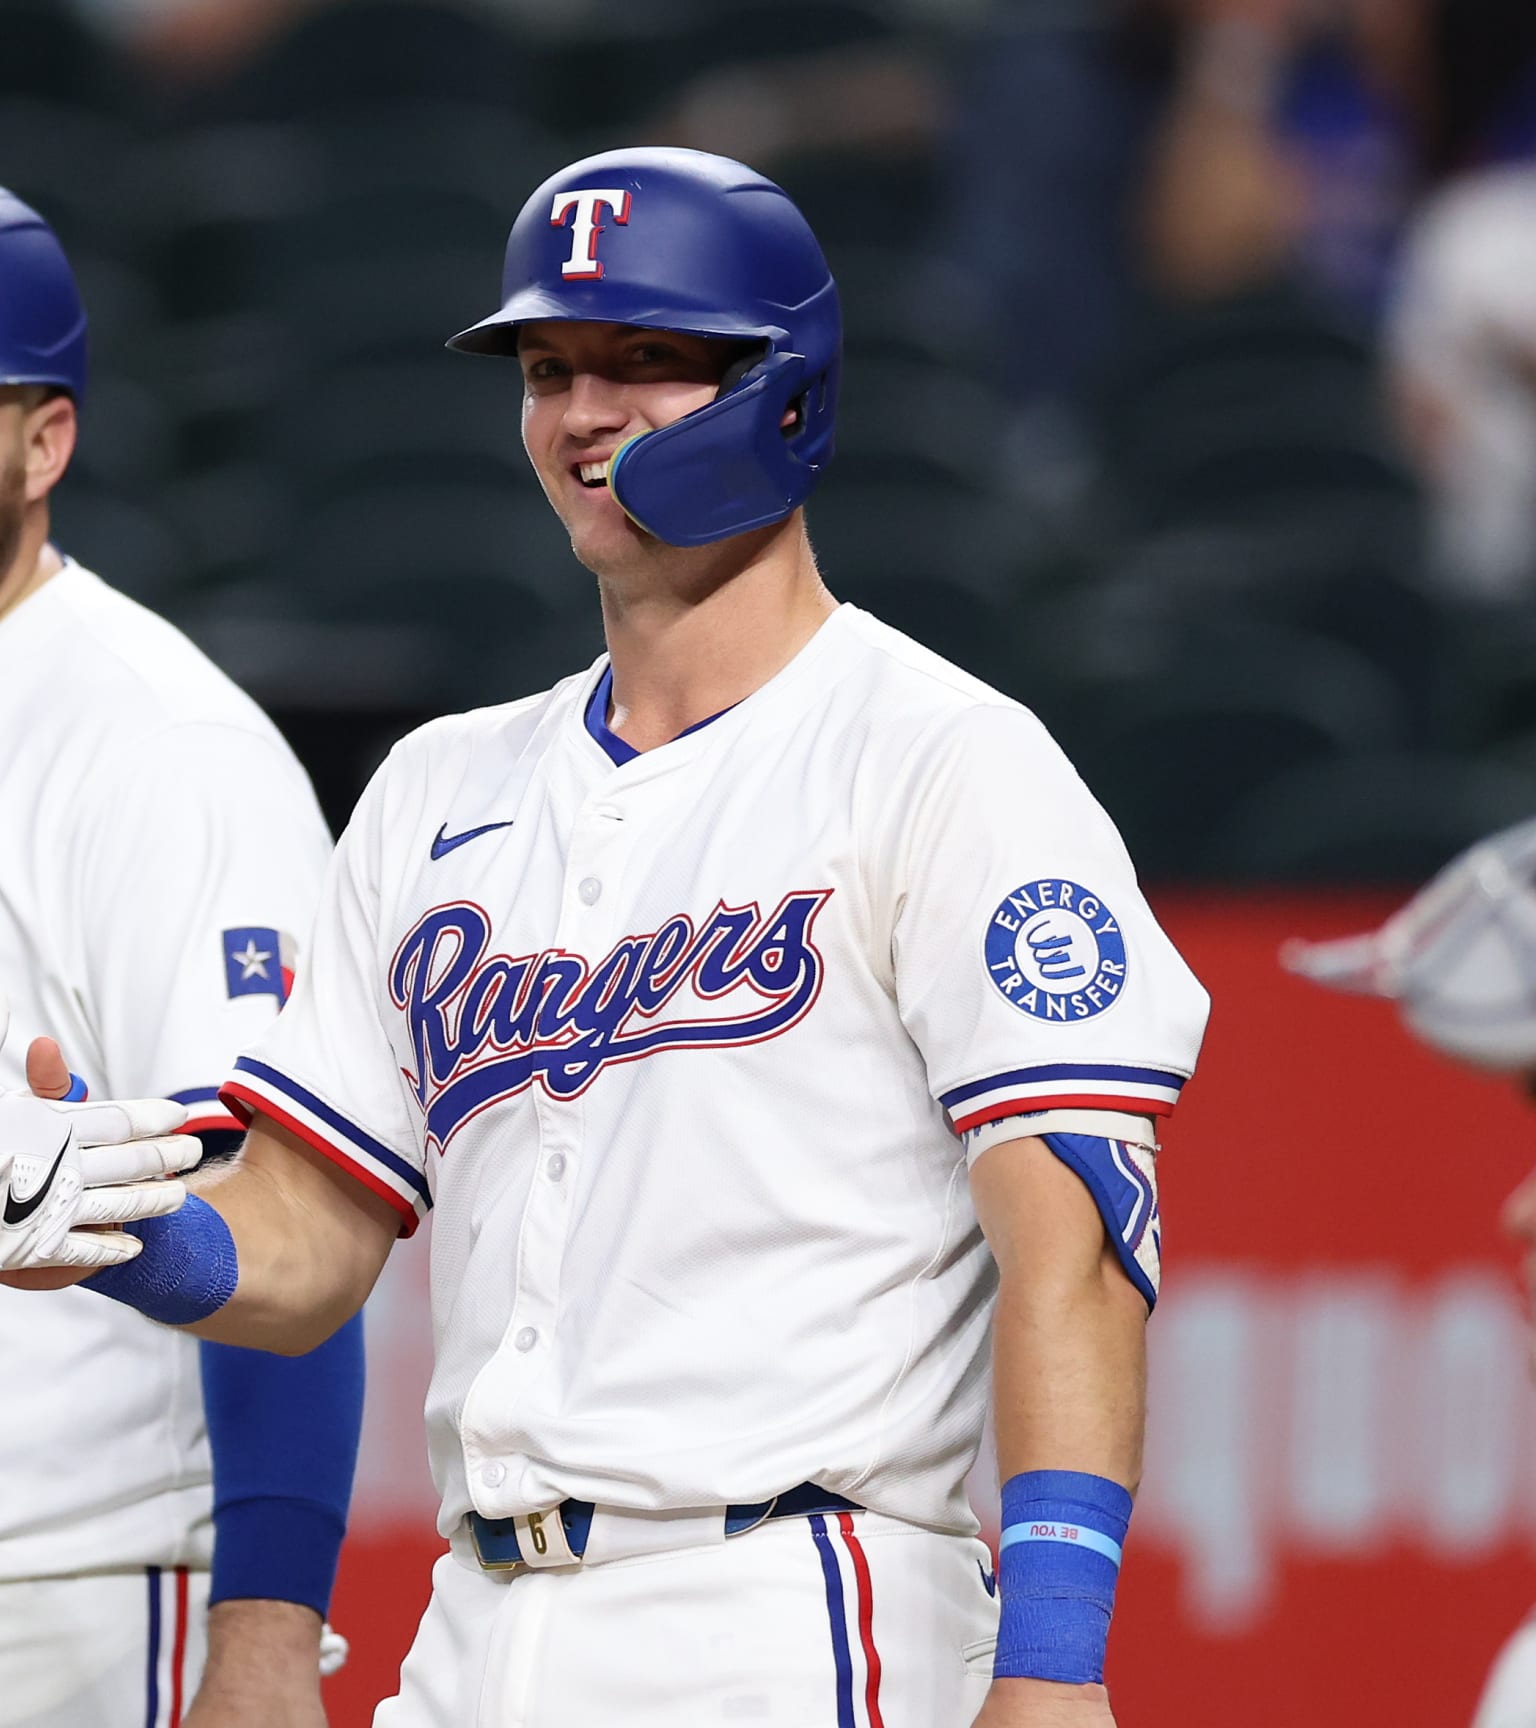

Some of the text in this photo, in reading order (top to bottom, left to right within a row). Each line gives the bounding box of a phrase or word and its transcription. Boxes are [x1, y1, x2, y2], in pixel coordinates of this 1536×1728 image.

[550, 189, 632, 281] T
[994, 882, 1118, 935] ENERGY
[990, 956, 1125, 1021] TRANSFER
[388, 888, 835, 1156] Rangers
[528, 1512, 547, 1554] 6
[1031, 1525, 1078, 1540] BE YOU
